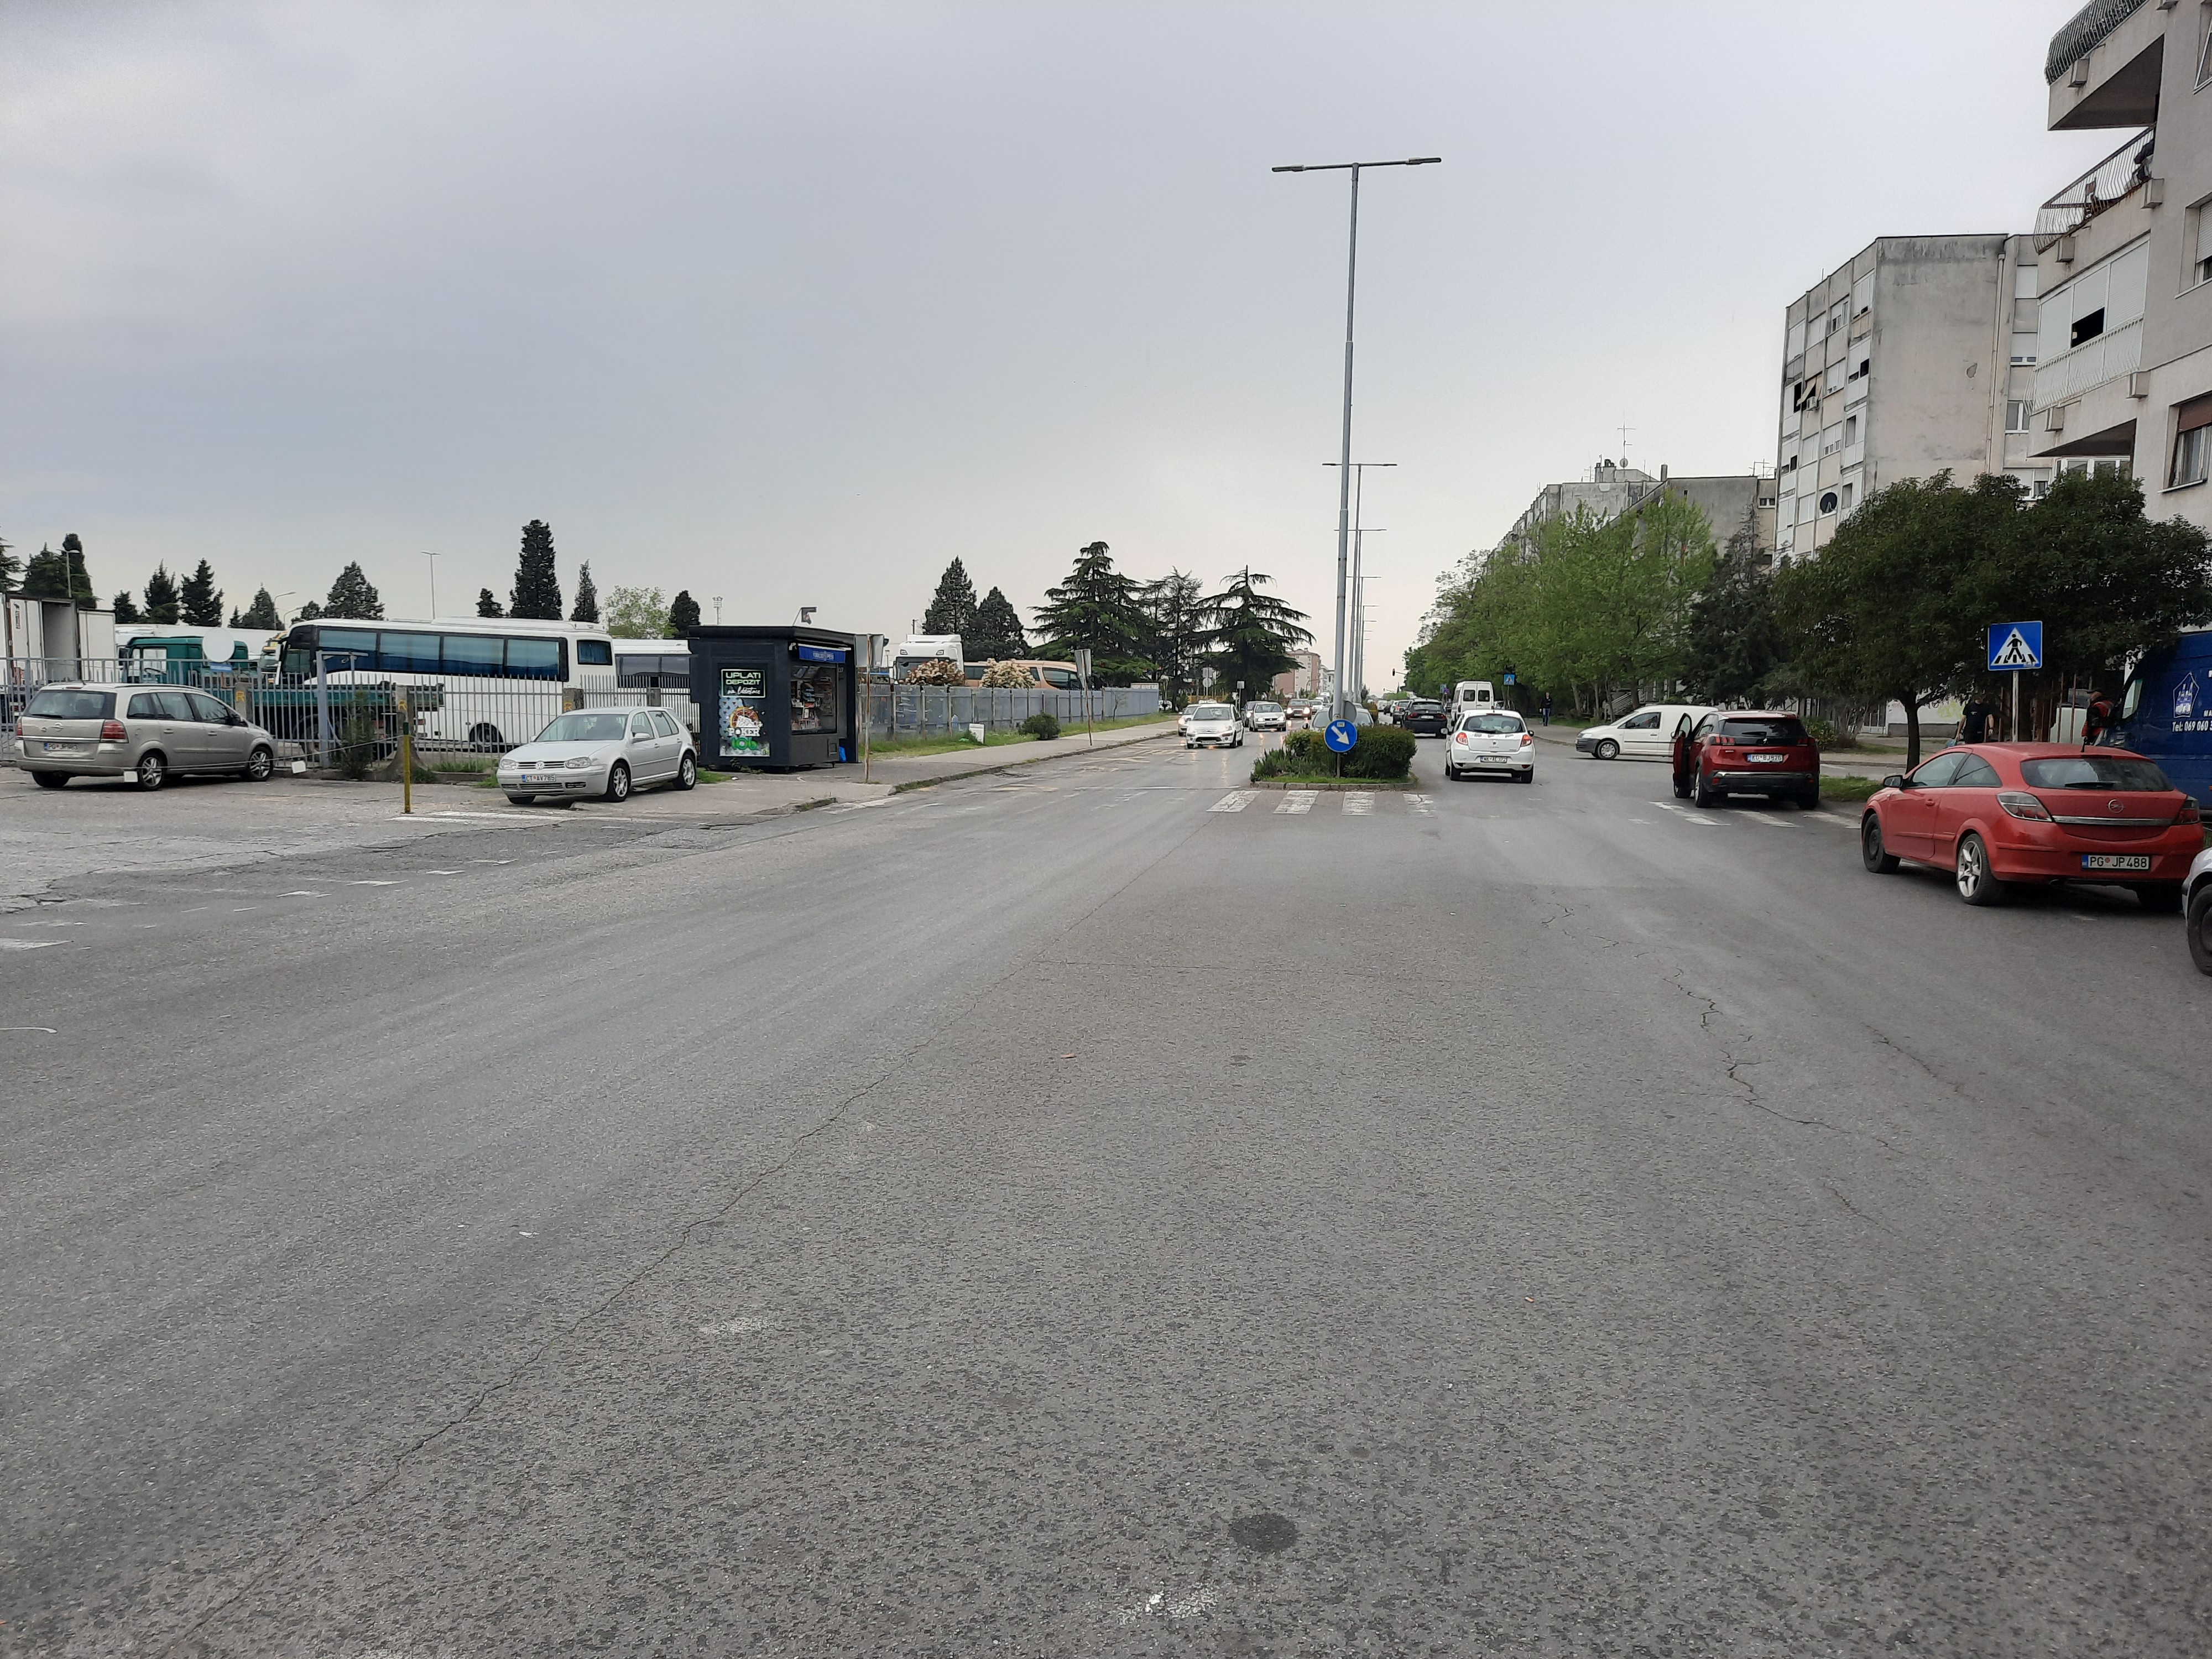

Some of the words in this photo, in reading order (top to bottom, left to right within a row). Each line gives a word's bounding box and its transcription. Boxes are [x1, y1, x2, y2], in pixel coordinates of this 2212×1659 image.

[2172, 721, 2183, 732] Tel:
[2184, 721, 2196, 732] 069
[2197, 720, 2209, 731] 060
[728, 727, 760, 737] POKER
[2090, 857, 2104, 867] PG
[2112, 857, 2147, 868] JP488
